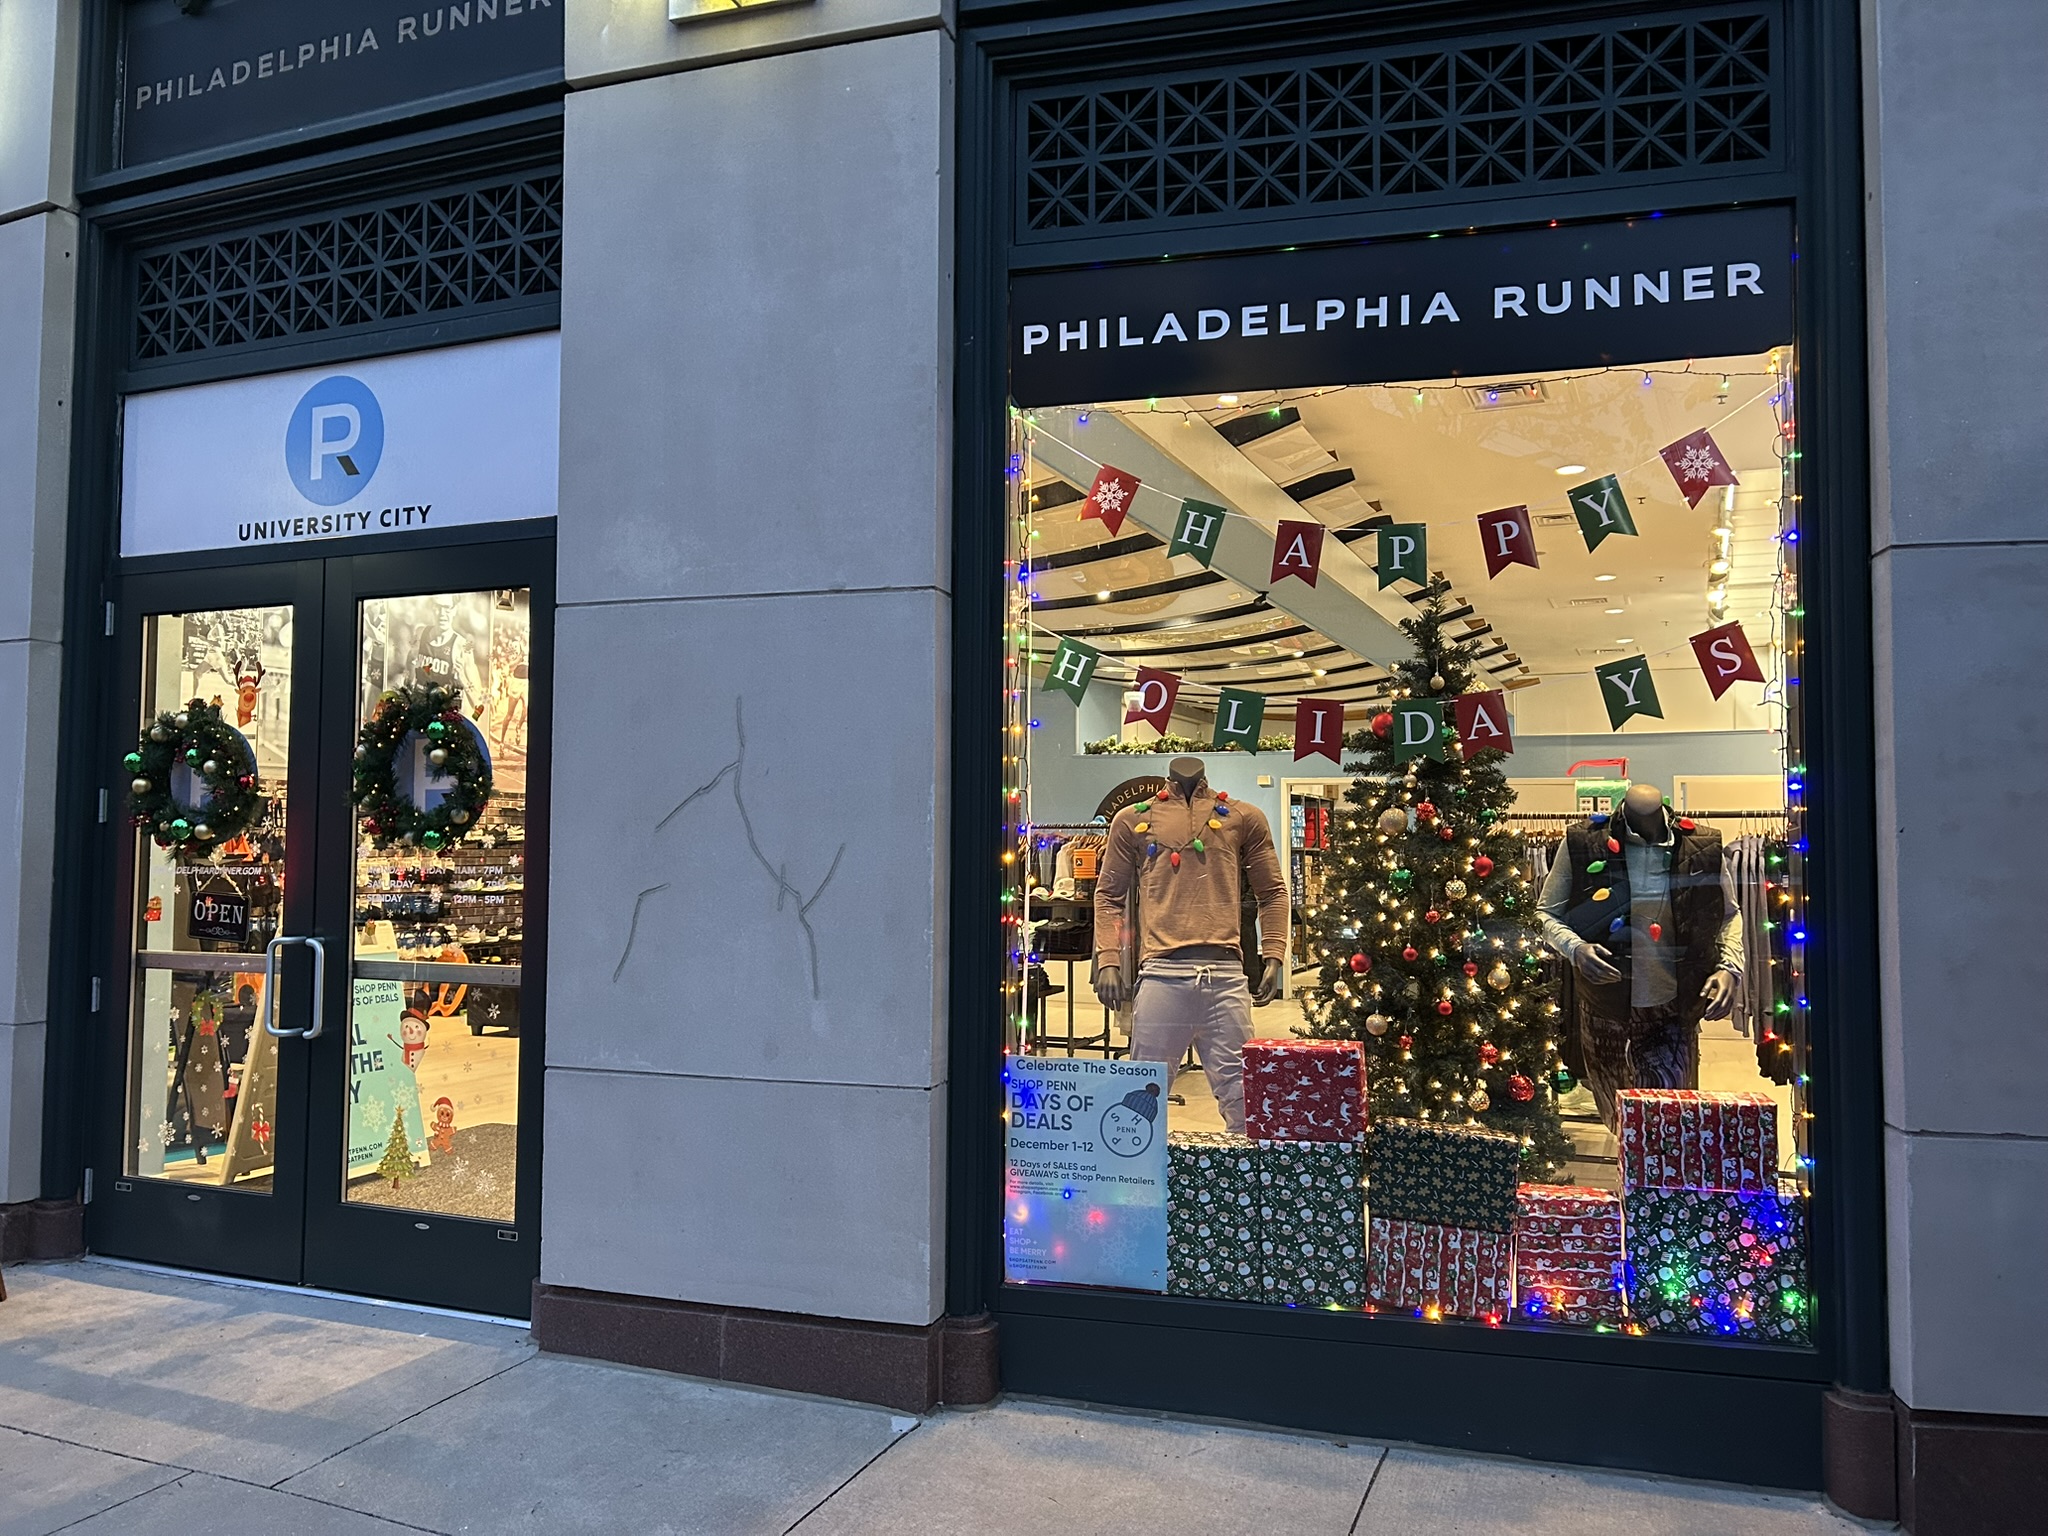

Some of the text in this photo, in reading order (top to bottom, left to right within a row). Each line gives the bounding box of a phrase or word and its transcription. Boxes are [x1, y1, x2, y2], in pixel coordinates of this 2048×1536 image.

[136, 27, 379, 110] PHILADELPHIA
[1023, 262, 1764, 355] PHILADELPHIA RUNNER
[238, 504, 432, 541] UNIVERSITY CITY
[483, 866, 503, 875] 7PM
[367, 893, 403, 903] SUNDAY
[453, 895, 477, 904] 12PM
[484, 895, 504, 904] 5PM
[194, 901, 244, 924] OPEN
[354, 982, 398, 994] SHOP PENN
[363, 996, 373, 1005] OF
[376, 993, 399, 1004] DEALS
[351, 1050, 384, 1075] THE
[1016, 1059, 1157, 1077] Celebrate The Season
[1011, 1078, 1077, 1091] SHOP PENN
[1011, 1092, 1094, 1112] DAYS OF
[1011, 1112, 1073, 1131] DEALS
[1116, 1126, 1137, 1134] PENN
[1010, 1137, 1094, 1152] December 1-12
[1010, 1159, 1097, 1172] 12 Days of SALES and
[1010, 1168, 1155, 1186] GIVEAWAYS at Shop Penn Retailers
[1009, 1227, 1023, 1235] EAT
[1009, 1237, 1031, 1245] SHOP
[1009, 1246, 1047, 1256] BE MERRY
